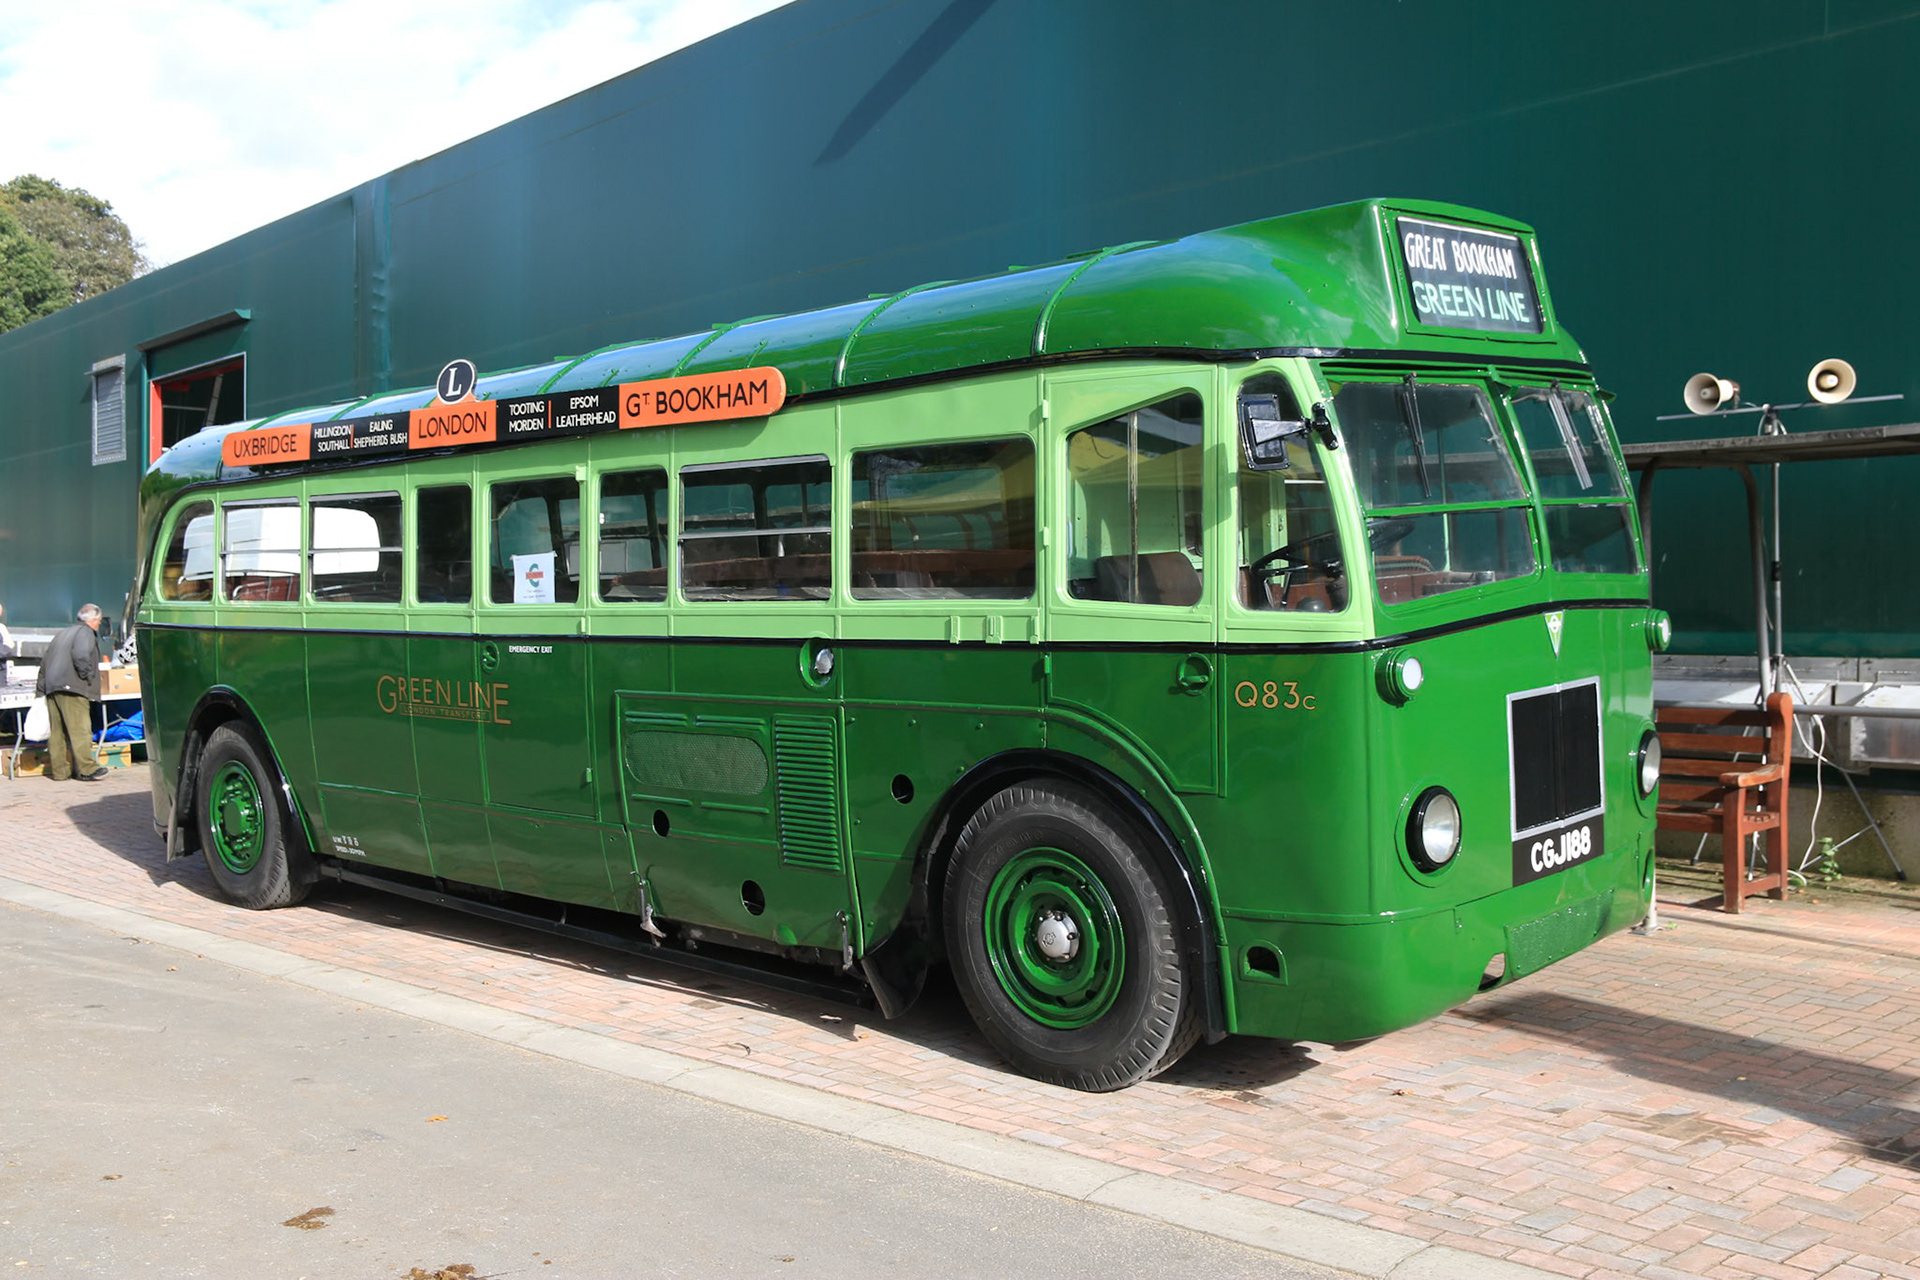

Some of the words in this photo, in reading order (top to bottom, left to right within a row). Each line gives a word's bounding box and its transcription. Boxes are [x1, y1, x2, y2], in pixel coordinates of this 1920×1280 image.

[1404, 232, 1447, 271] GREAT
[1451, 240, 1518, 280] BOOKHAM
[1411, 280, 1485, 318] GREEN
[1486, 287, 1530, 323] LINE
[445, 367, 462, 397] L
[569, 395, 599, 410] EPSOM
[656, 379, 768, 415] BOOKHAM
[509, 401, 545, 416] TOOTING
[369, 419, 393, 433] EALING
[418, 411, 487, 439] LONDON
[509, 417, 544, 433] MORDEN
[556, 410, 616, 428] LEATHERHEAD
[314, 424, 352, 439] HILLINGDON
[233, 433, 297, 458] UXBRIDGE
[317, 440, 351, 453] SOUTHALL
[353, 435, 389, 449] SHEPHERDS
[390, 432, 408, 445] BUSH
[508, 645, 540, 654] EMERGENCY
[541, 645, 553, 654] EXIT
[377, 675, 451, 713] GREEN
[457, 681, 511, 725] LINE
